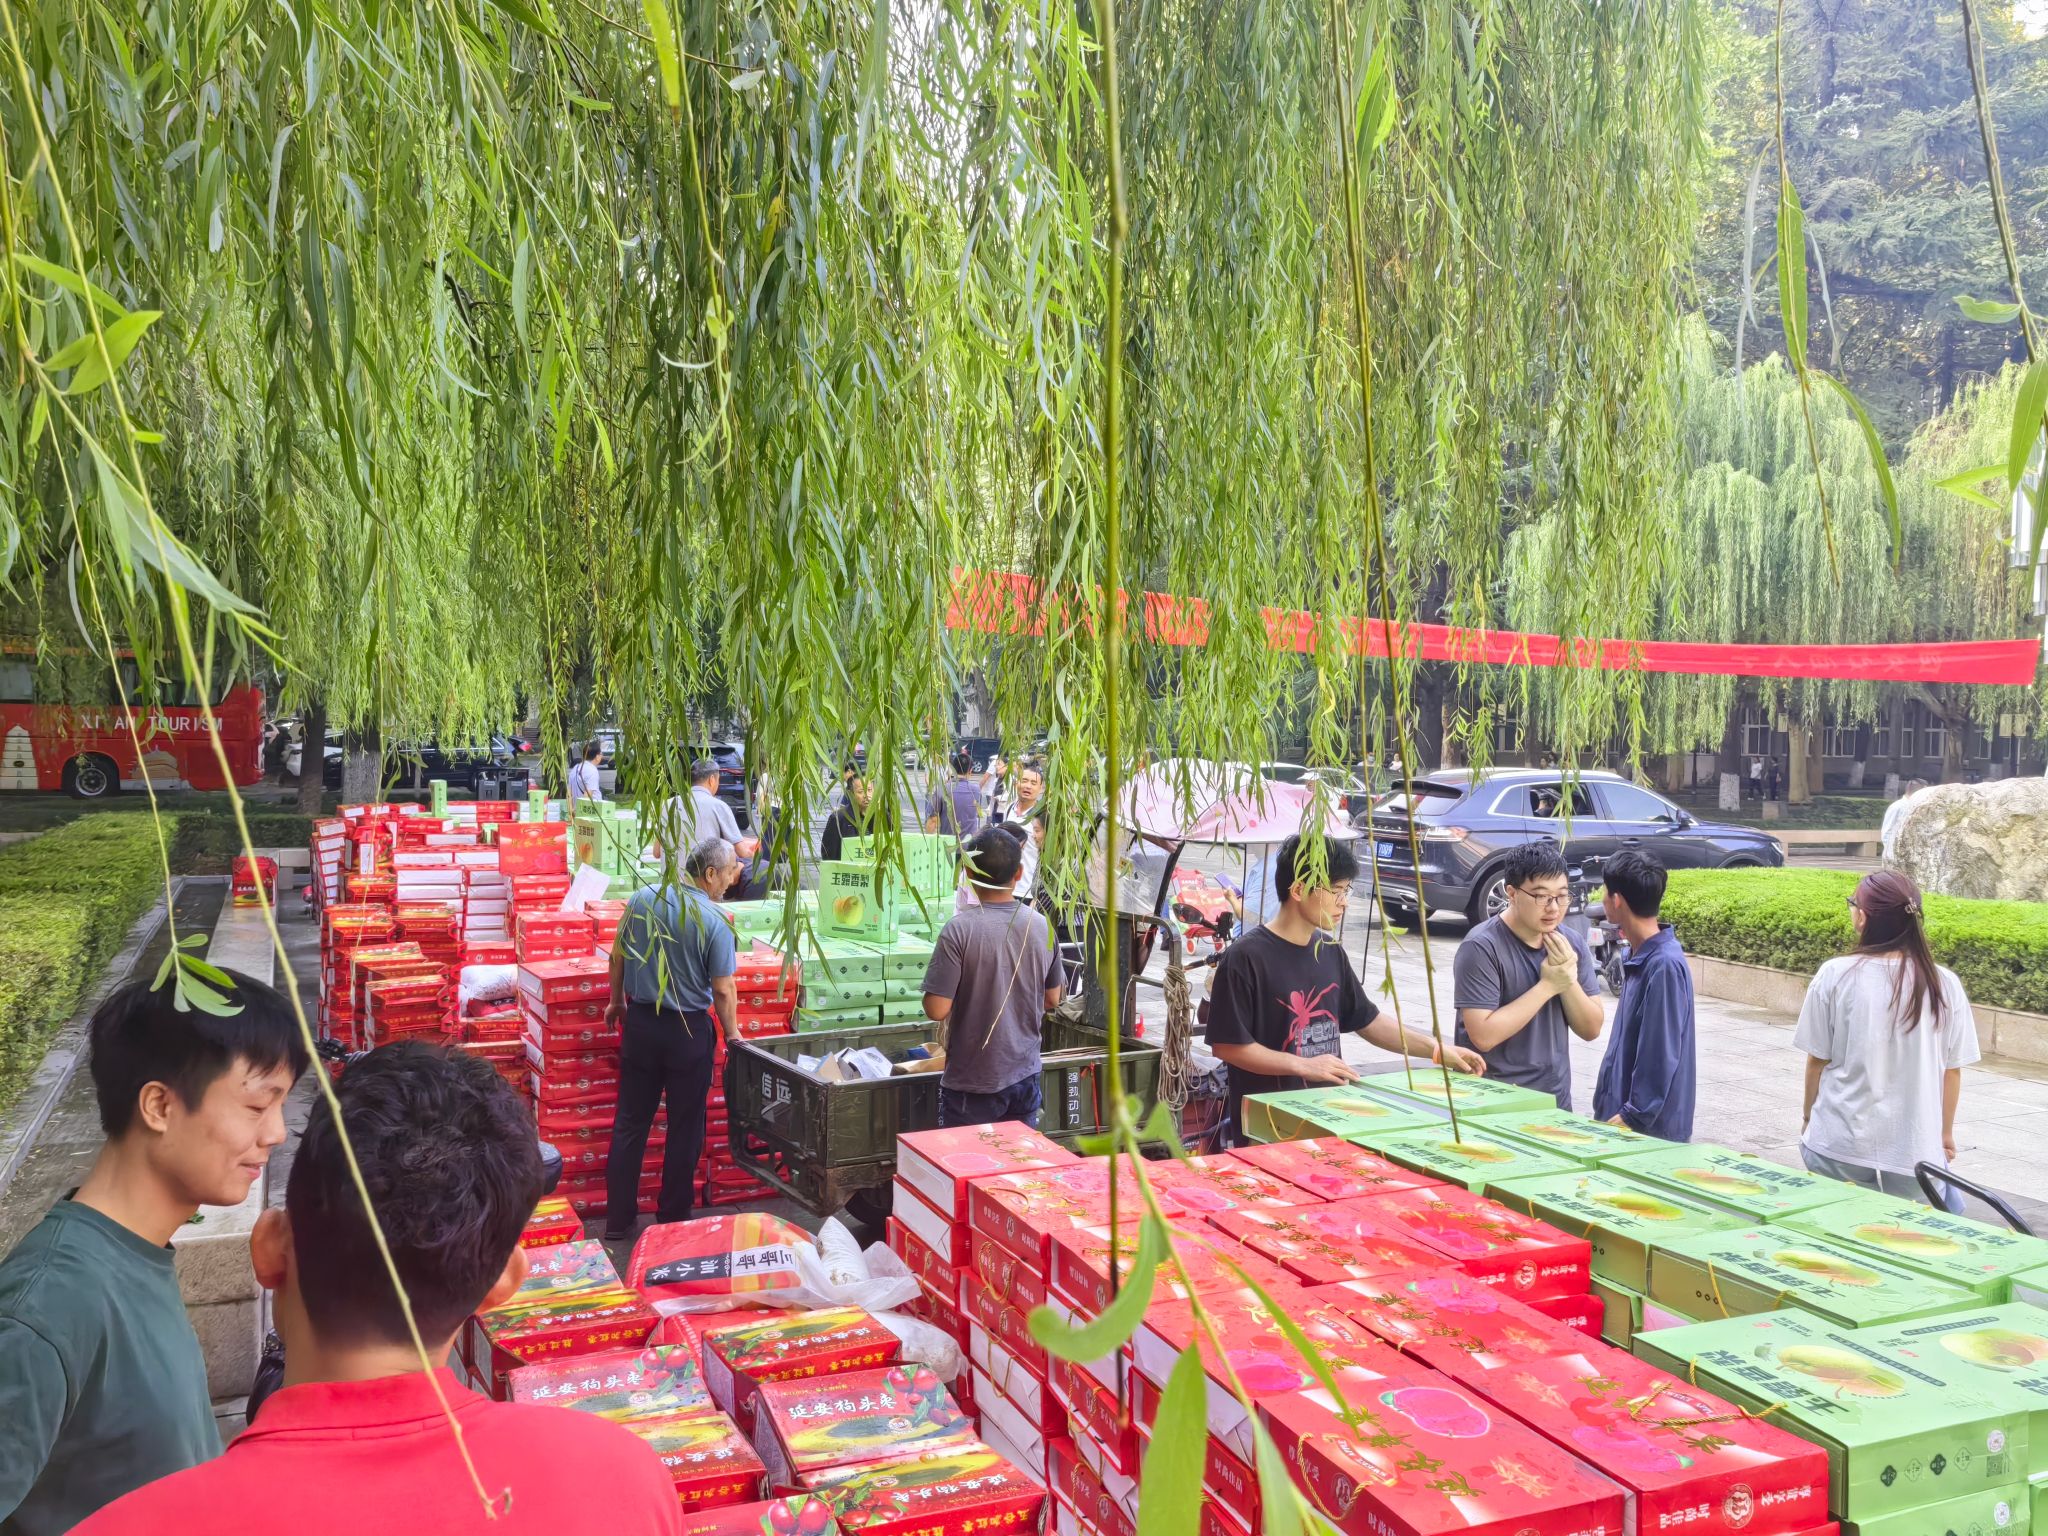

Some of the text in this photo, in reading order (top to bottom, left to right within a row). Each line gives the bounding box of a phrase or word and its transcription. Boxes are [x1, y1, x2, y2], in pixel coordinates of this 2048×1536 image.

[148, 716, 223, 731] TOURISM
[831, 871, 870, 888] 玉露香梨
[761, 1071, 792, 1105] 信远
[1067, 1071, 1081, 1125] 强劲动力
[1704, 1154, 1817, 1189] 玉露香梨
[1534, 1192, 1646, 1228] 玉露香梨
[1884, 1210, 2020, 1247] 玉露香梨
[736, 1249, 793, 1270] 三哥哥
[1709, 1251, 1847, 1298] 玉露香梨
[538, 1306, 637, 1326] 延安狗头枣
[587, 1328, 645, 1344] 五谷加红枣
[773, 1326, 872, 1351] 延安狗头枣
[828, 1352, 885, 1371] 五谷加红枣
[531, 1371, 645, 1401] 延安狗头枣
[1697, 1350, 1850, 1417] 玉露香梨
[788, 1392, 898, 1420] 延安狗头枣
[888, 1472, 1009, 1504] 延安狗头枣
[961, 1508, 1029, 1532] 五谷加红枣
